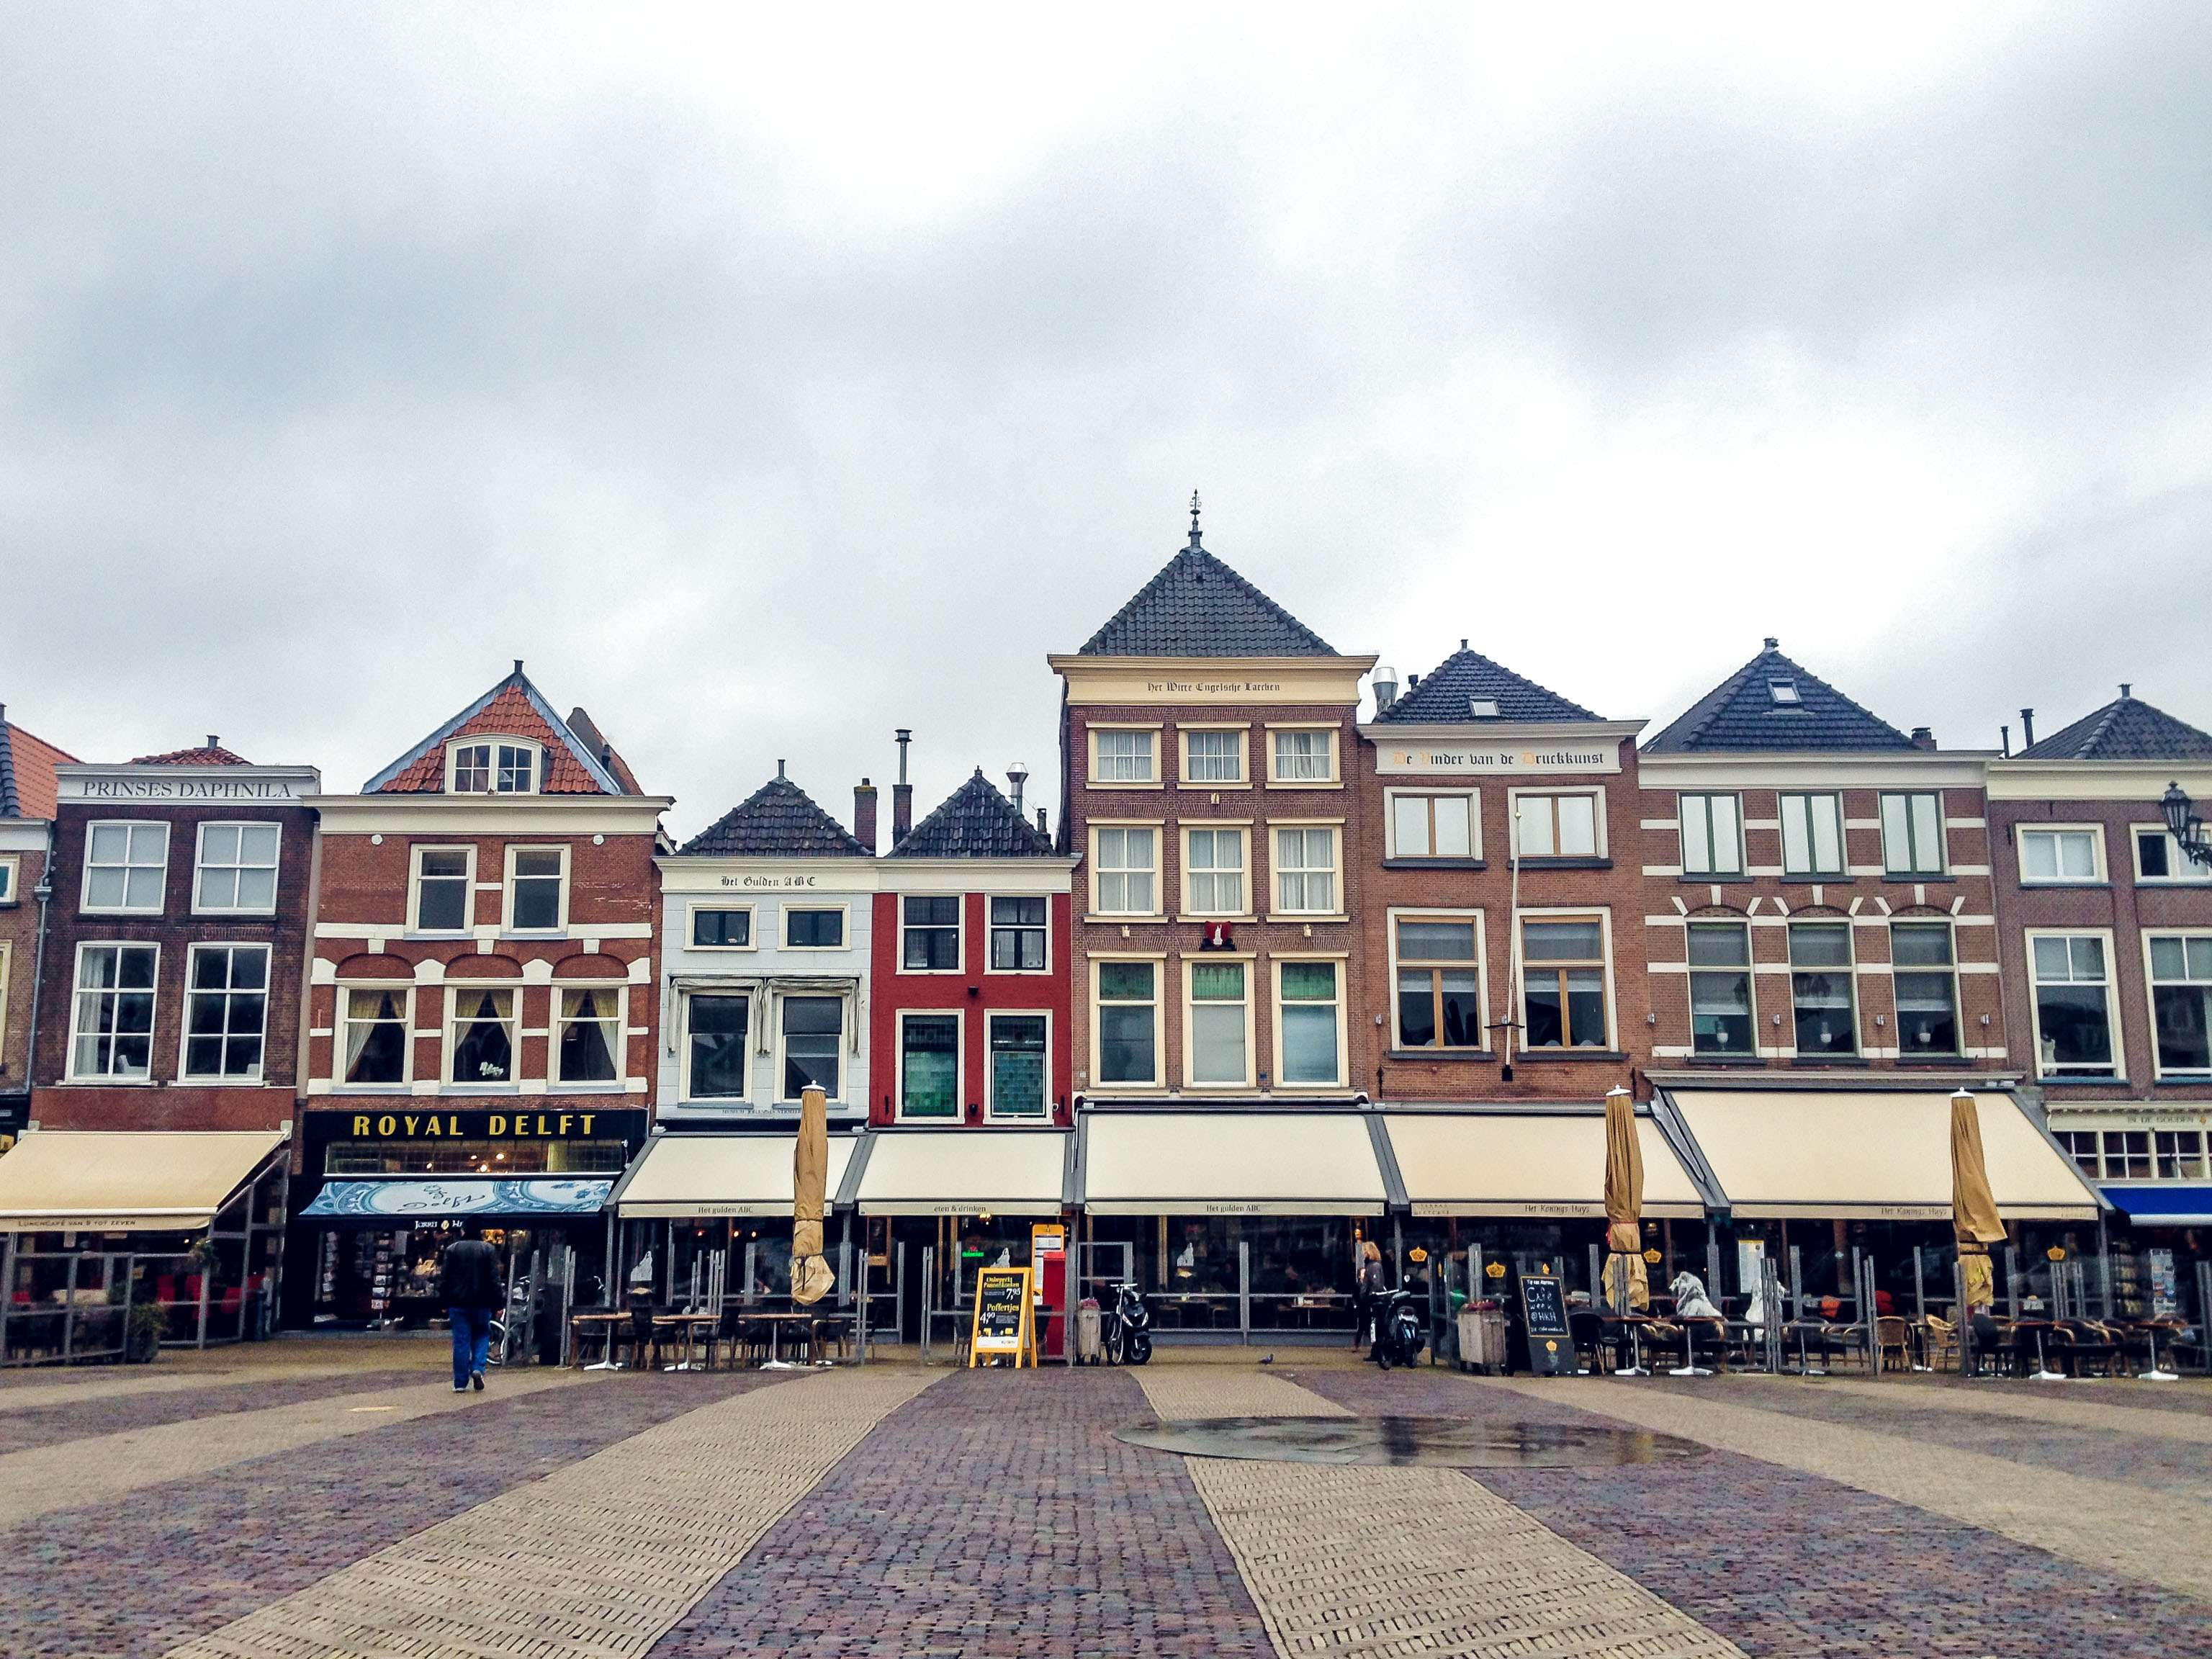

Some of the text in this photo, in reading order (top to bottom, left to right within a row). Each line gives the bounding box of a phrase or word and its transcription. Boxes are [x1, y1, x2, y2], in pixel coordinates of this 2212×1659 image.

[1148, 683, 1162, 693] Het
[1166, 683, 1192, 692] Witte
[1195, 683, 1241, 693] Engelsche
[1394, 751, 1412, 765] De
[1470, 753, 1493, 765] van
[1500, 753, 1514, 765] de
[1522, 751, 1604, 765] Druckkunst
[84, 781, 292, 798] PRINSES DAPHNILA
[721, 875, 737, 886] Het
[743, 875, 779, 886] Gulden
[354, 1115, 596, 1136] ROYAL DELFT
[712, 1205, 736, 1215] gulden
[987, 1303, 1019, 1313] Poffertjes
[980, 1312, 995, 1324] 4,90
